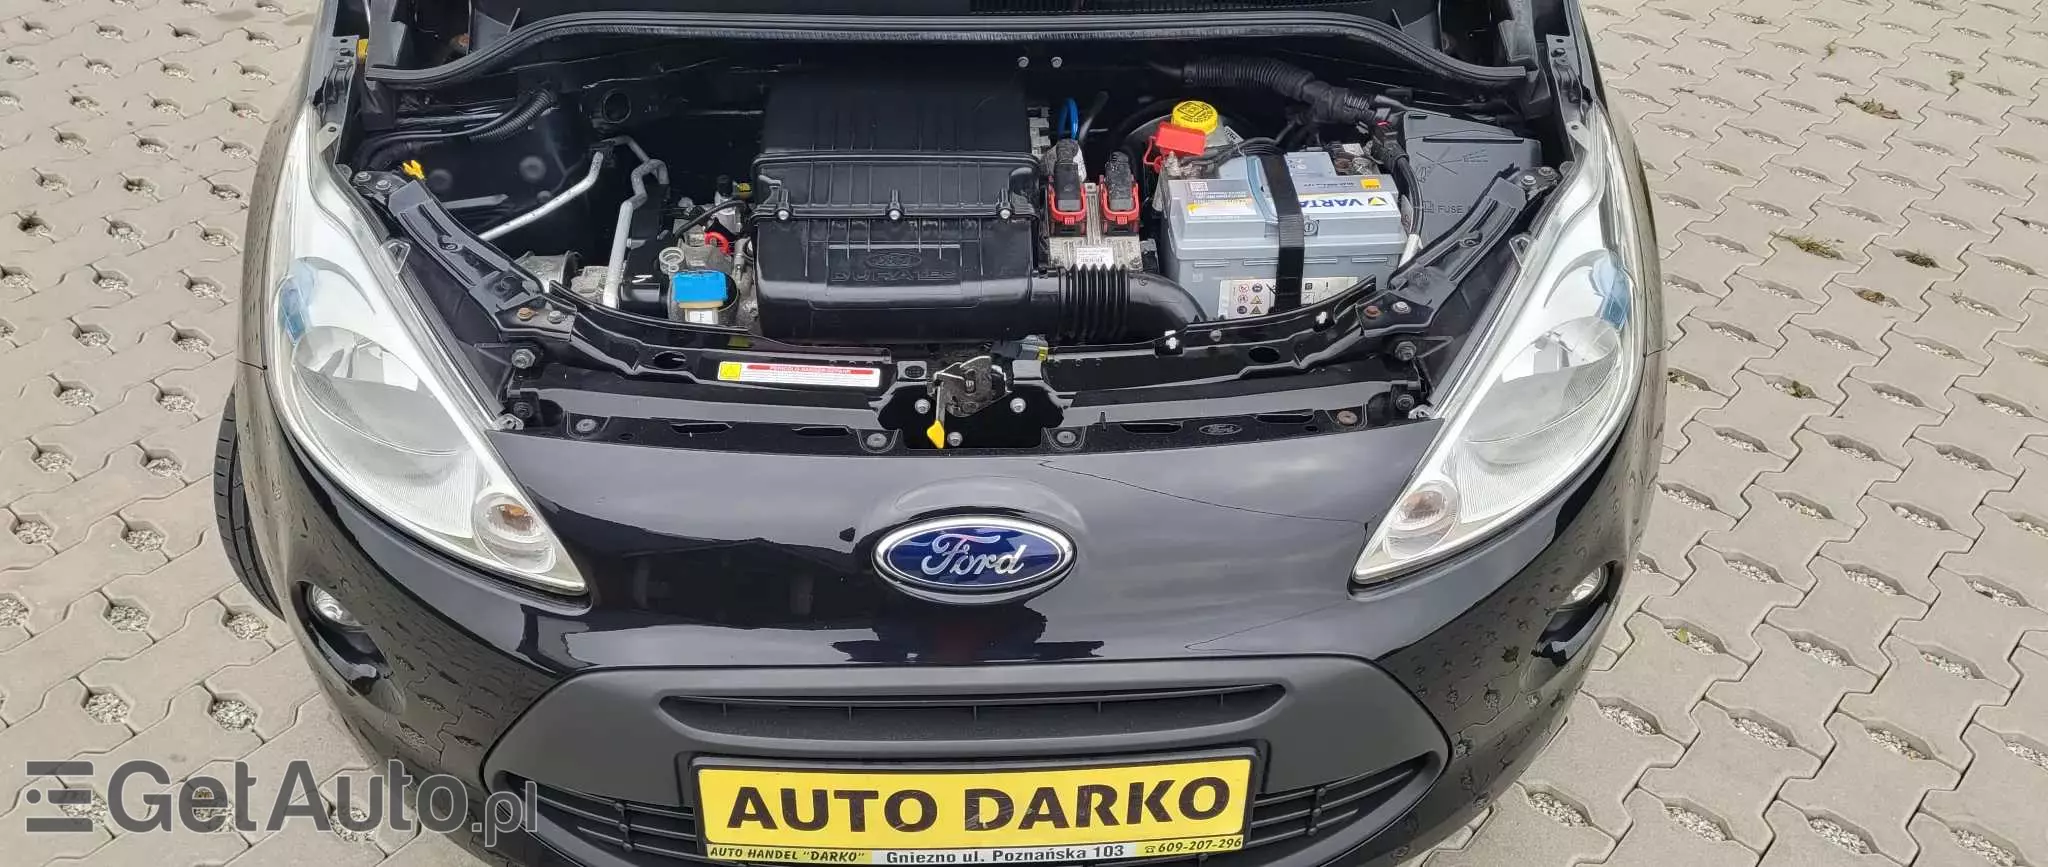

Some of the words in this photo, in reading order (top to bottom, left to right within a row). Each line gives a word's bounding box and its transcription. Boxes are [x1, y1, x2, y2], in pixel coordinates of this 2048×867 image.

[1437, 205, 1464, 214] FUSE
[920, 533, 1028, 576] Ford
[727, 786, 938, 833] AUTO
[964, 776, 1231, 832] DARKO
[710, 847, 743, 859] AUTO
[748, 849, 799, 861] HANDEL
[886, 851, 957, 865] Gniezno
[963, 850, 985, 863] ul.
[992, 847, 1087, 863] Poznańska
[1095, 845, 1125, 858] 103
[1157, 837, 1242, 853] 609-207-296
